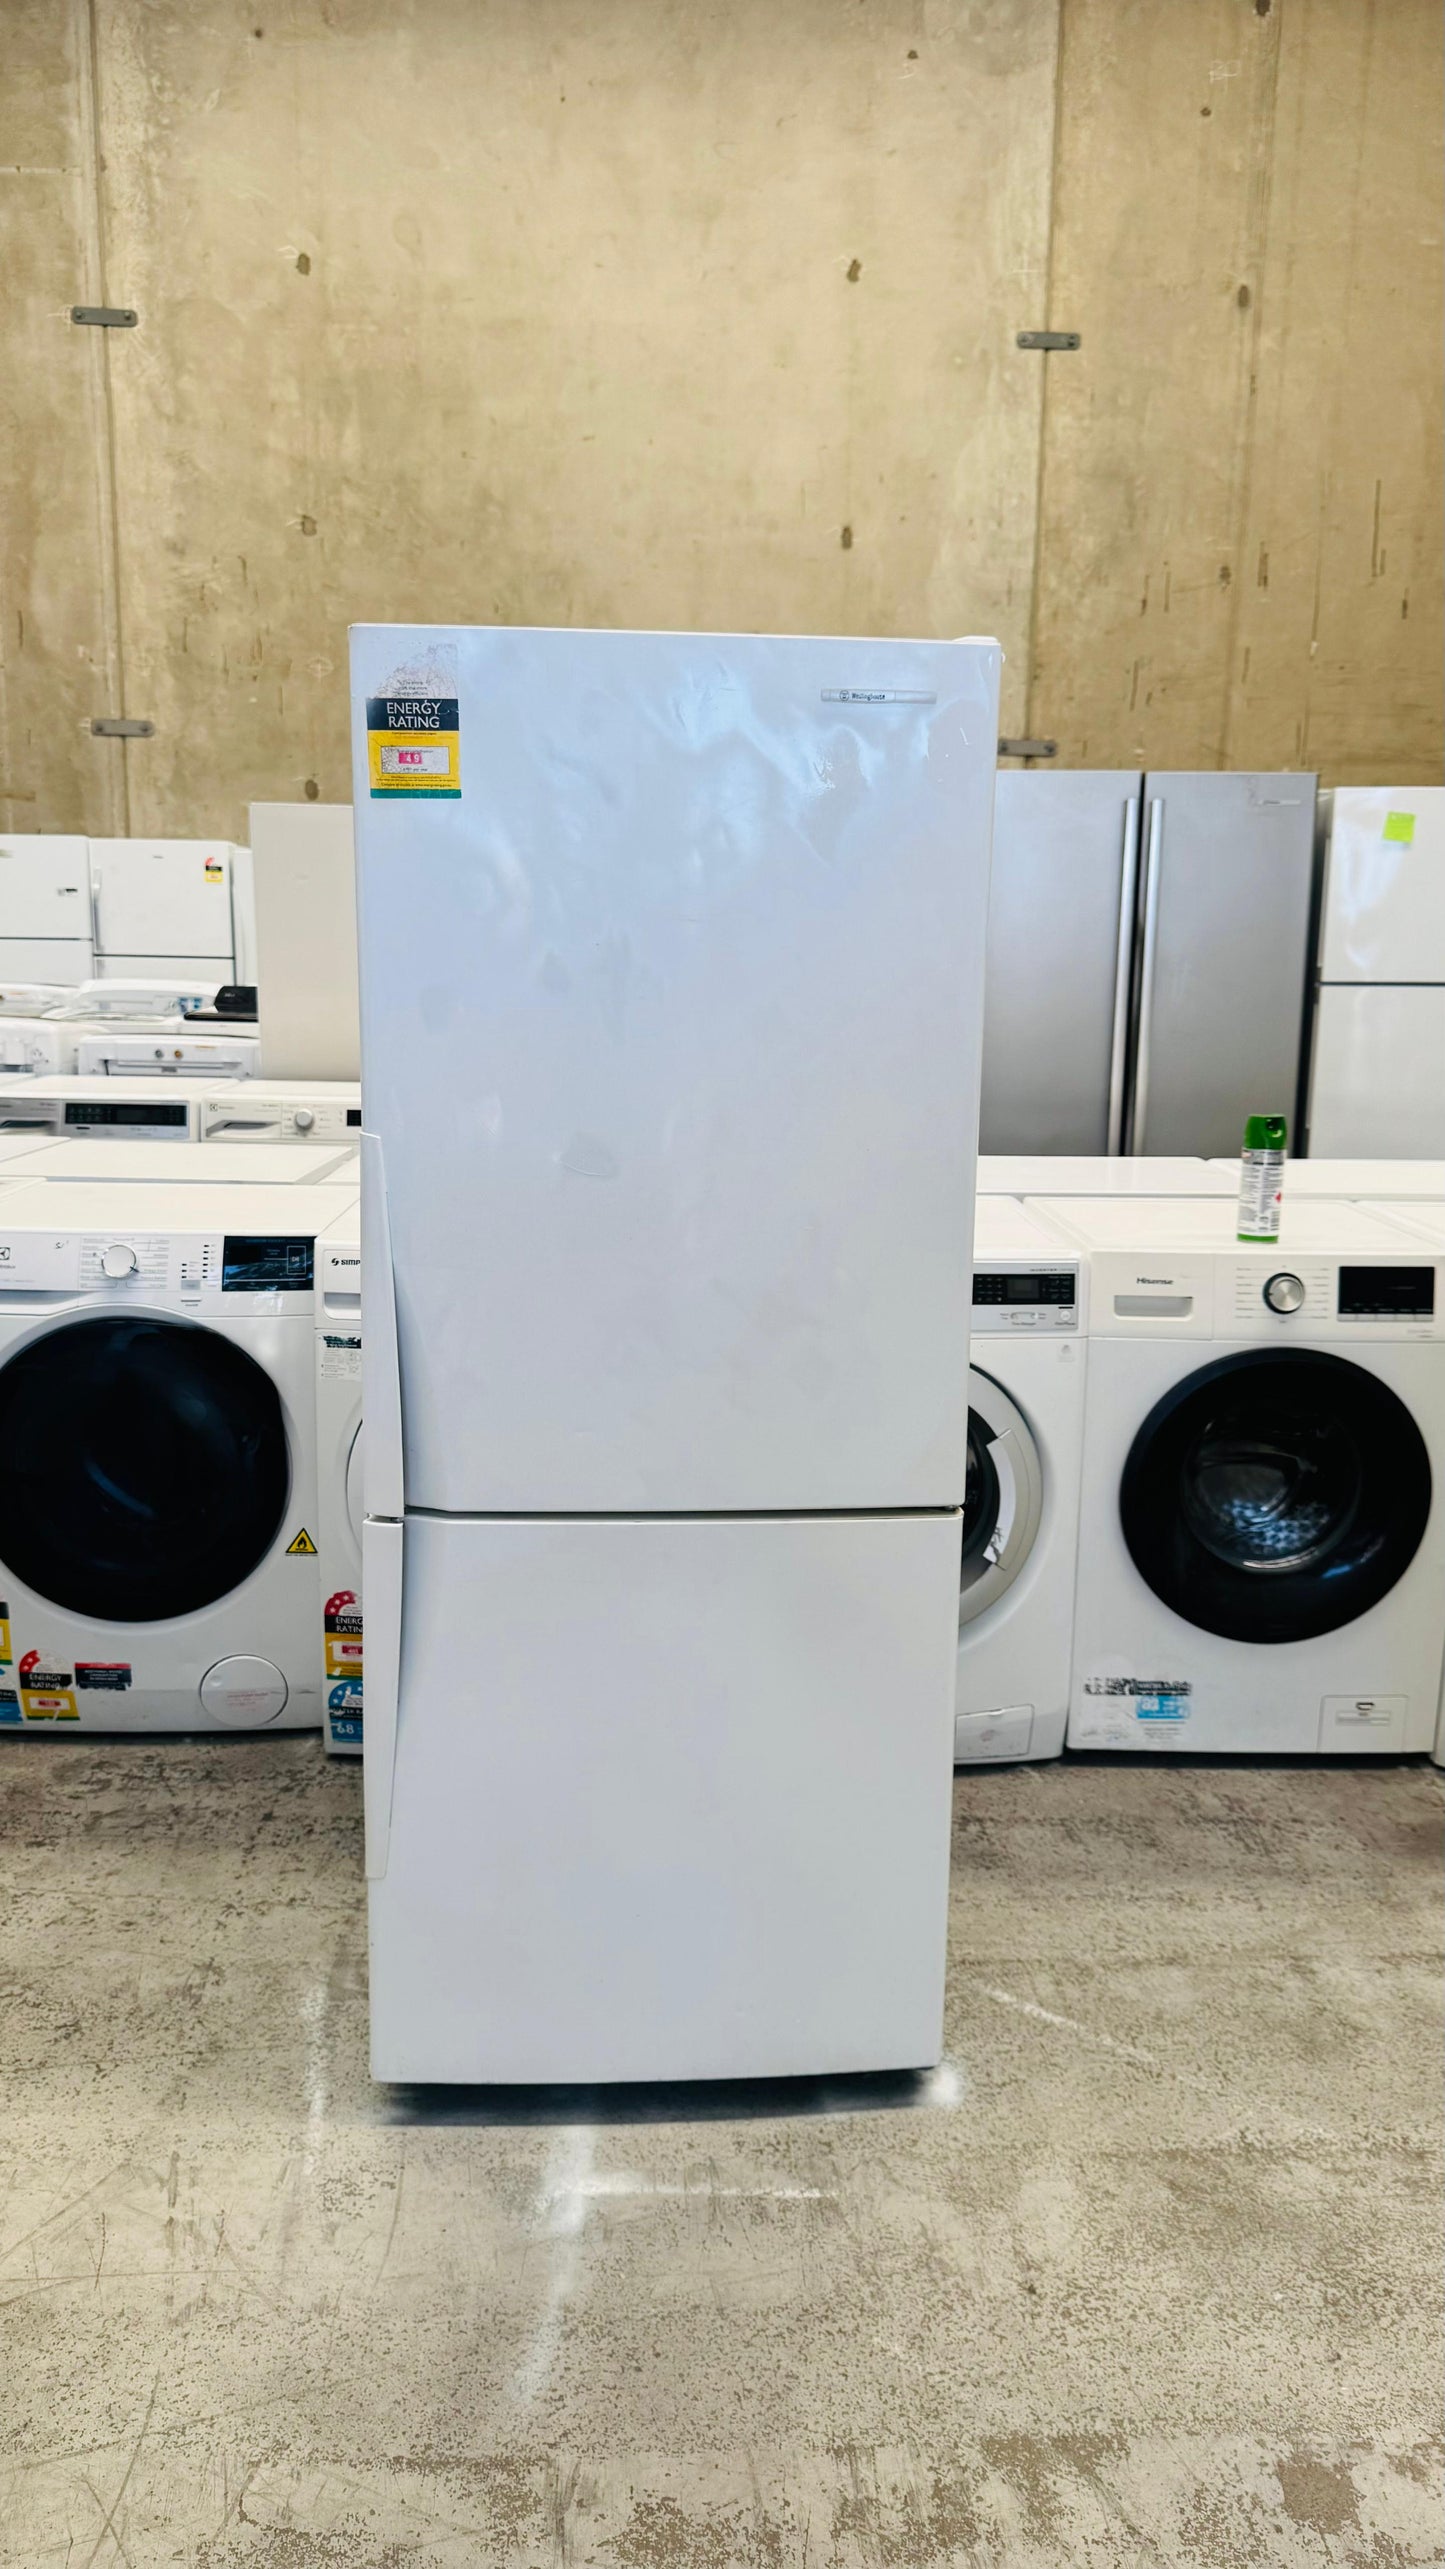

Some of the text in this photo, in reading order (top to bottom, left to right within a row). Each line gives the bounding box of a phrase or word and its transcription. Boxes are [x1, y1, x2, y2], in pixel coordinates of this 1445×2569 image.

[386, 702, 440, 715] ENERGY
[388, 716, 440, 728] RATING
[1136, 1277, 1174, 1285] Hisense
